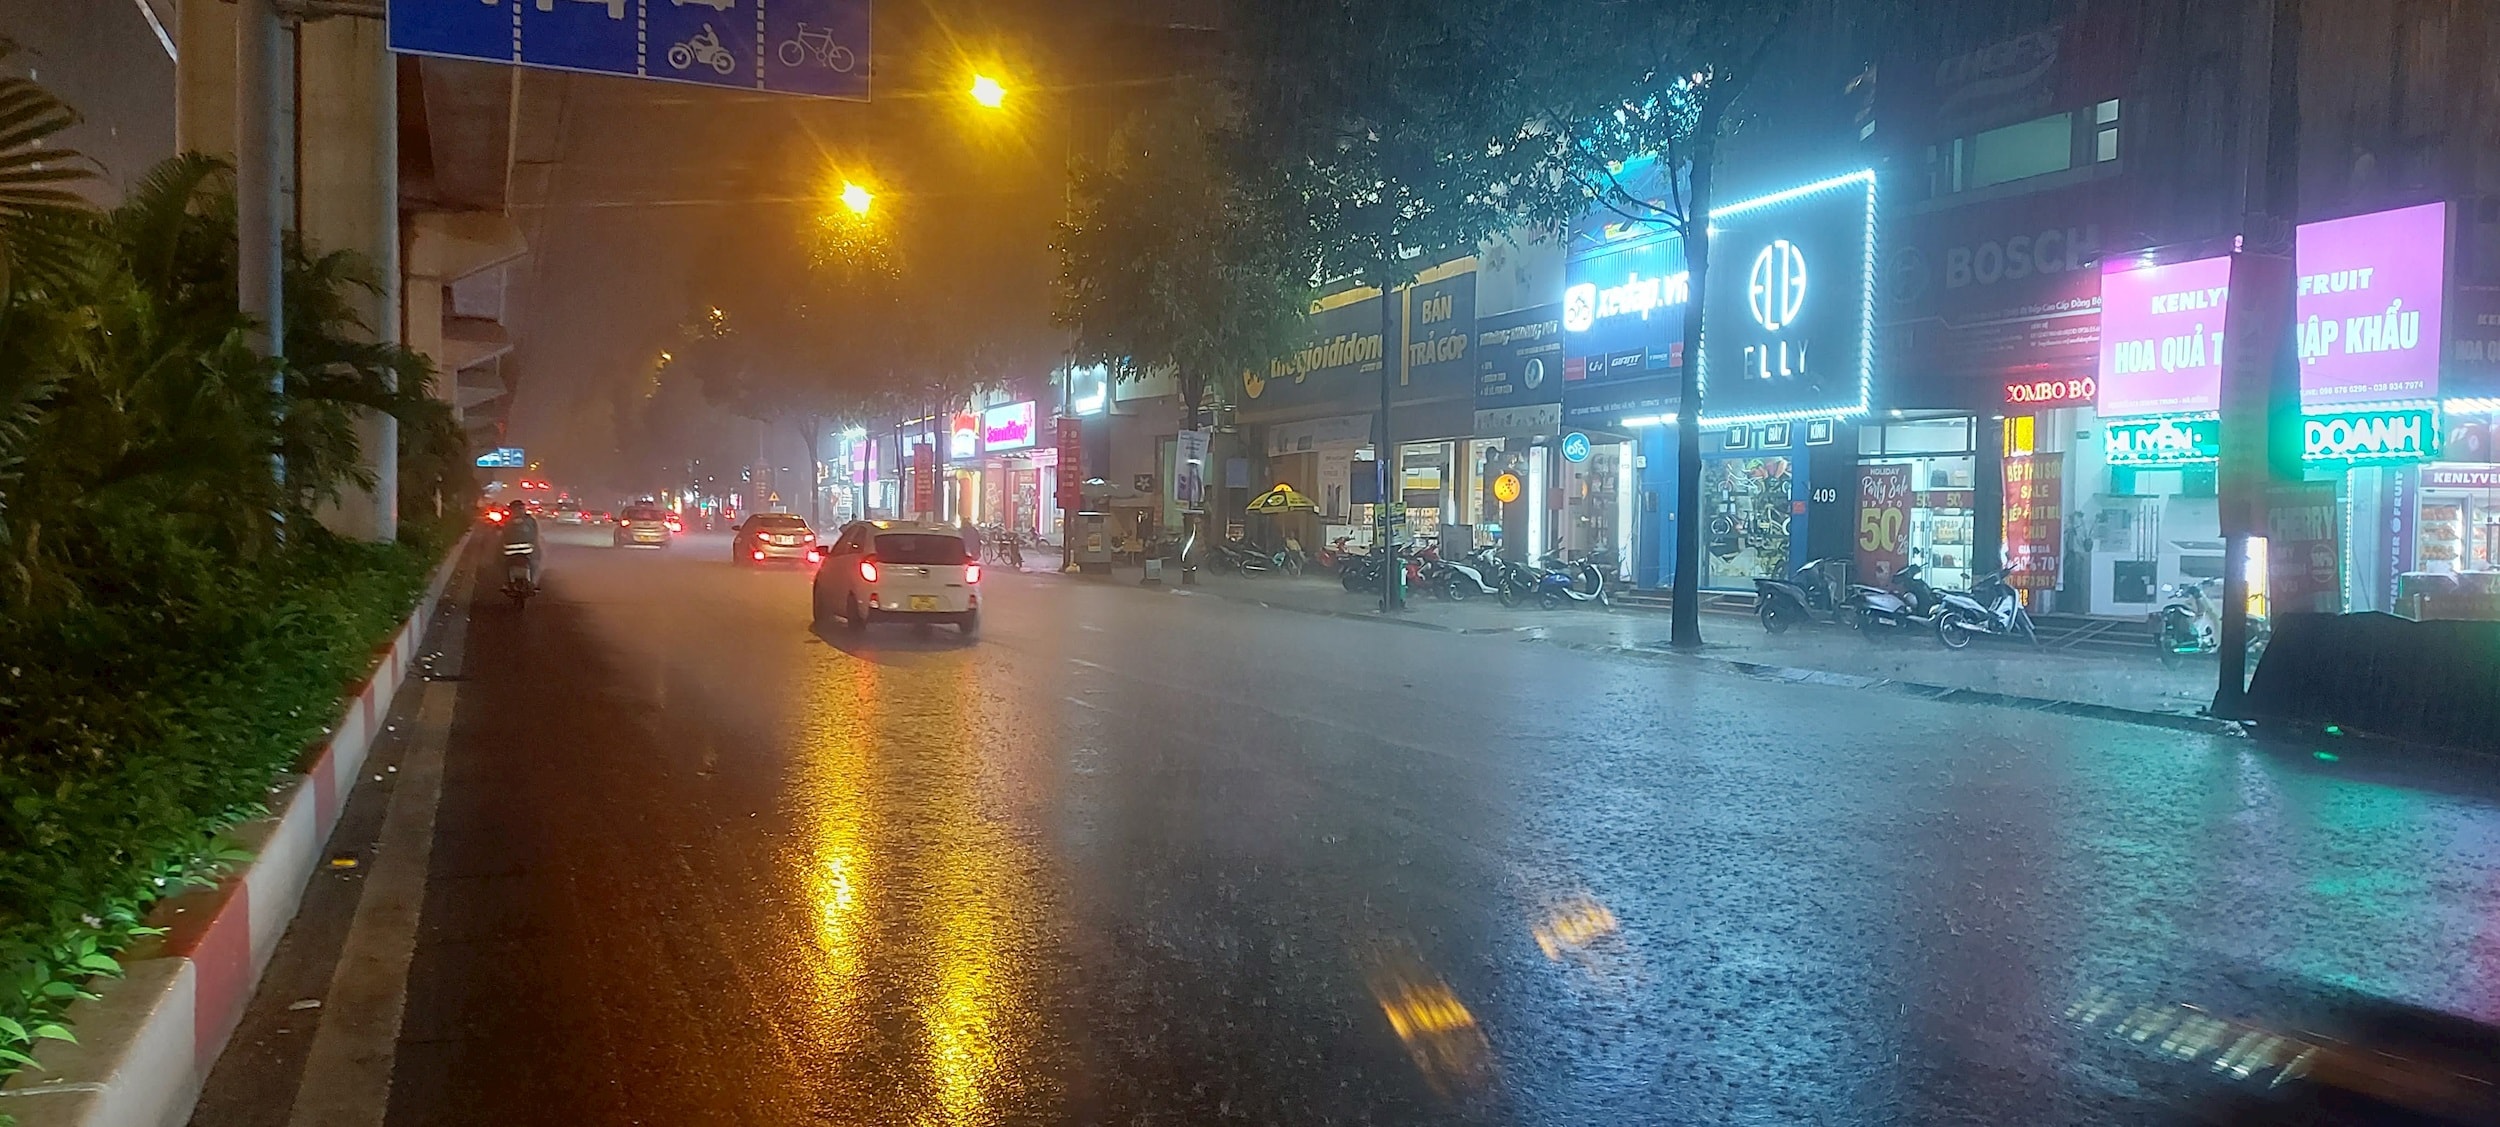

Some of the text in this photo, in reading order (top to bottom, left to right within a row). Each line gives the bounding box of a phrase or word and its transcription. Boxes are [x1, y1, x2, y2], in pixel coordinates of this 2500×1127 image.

[1946, 224, 2101, 288] BOSCH
[2299, 268, 2374, 297] FRUIT
[1422, 291, 1453, 325] BÁN
[2345, 298, 2420, 354] KHẨU
[1410, 330, 1435, 367] TRẢ
[1436, 328, 1468, 361] GÓP
[1744, 339, 1809, 380] ELLY
[2115, 339, 2156, 374] HOA
[2161, 323, 2206, 374] QUẢ
[2069, 376, 2097, 401] BỘ
[2304, 415, 2421, 452] DOANH
[1870, 467, 1900, 476] HOLIDAY
[1813, 488, 1837, 503] 409
[1861, 475, 1887, 504] Party
[2020, 484, 2049, 499] SALE
[2393, 470, 2404, 516] FRUIT
